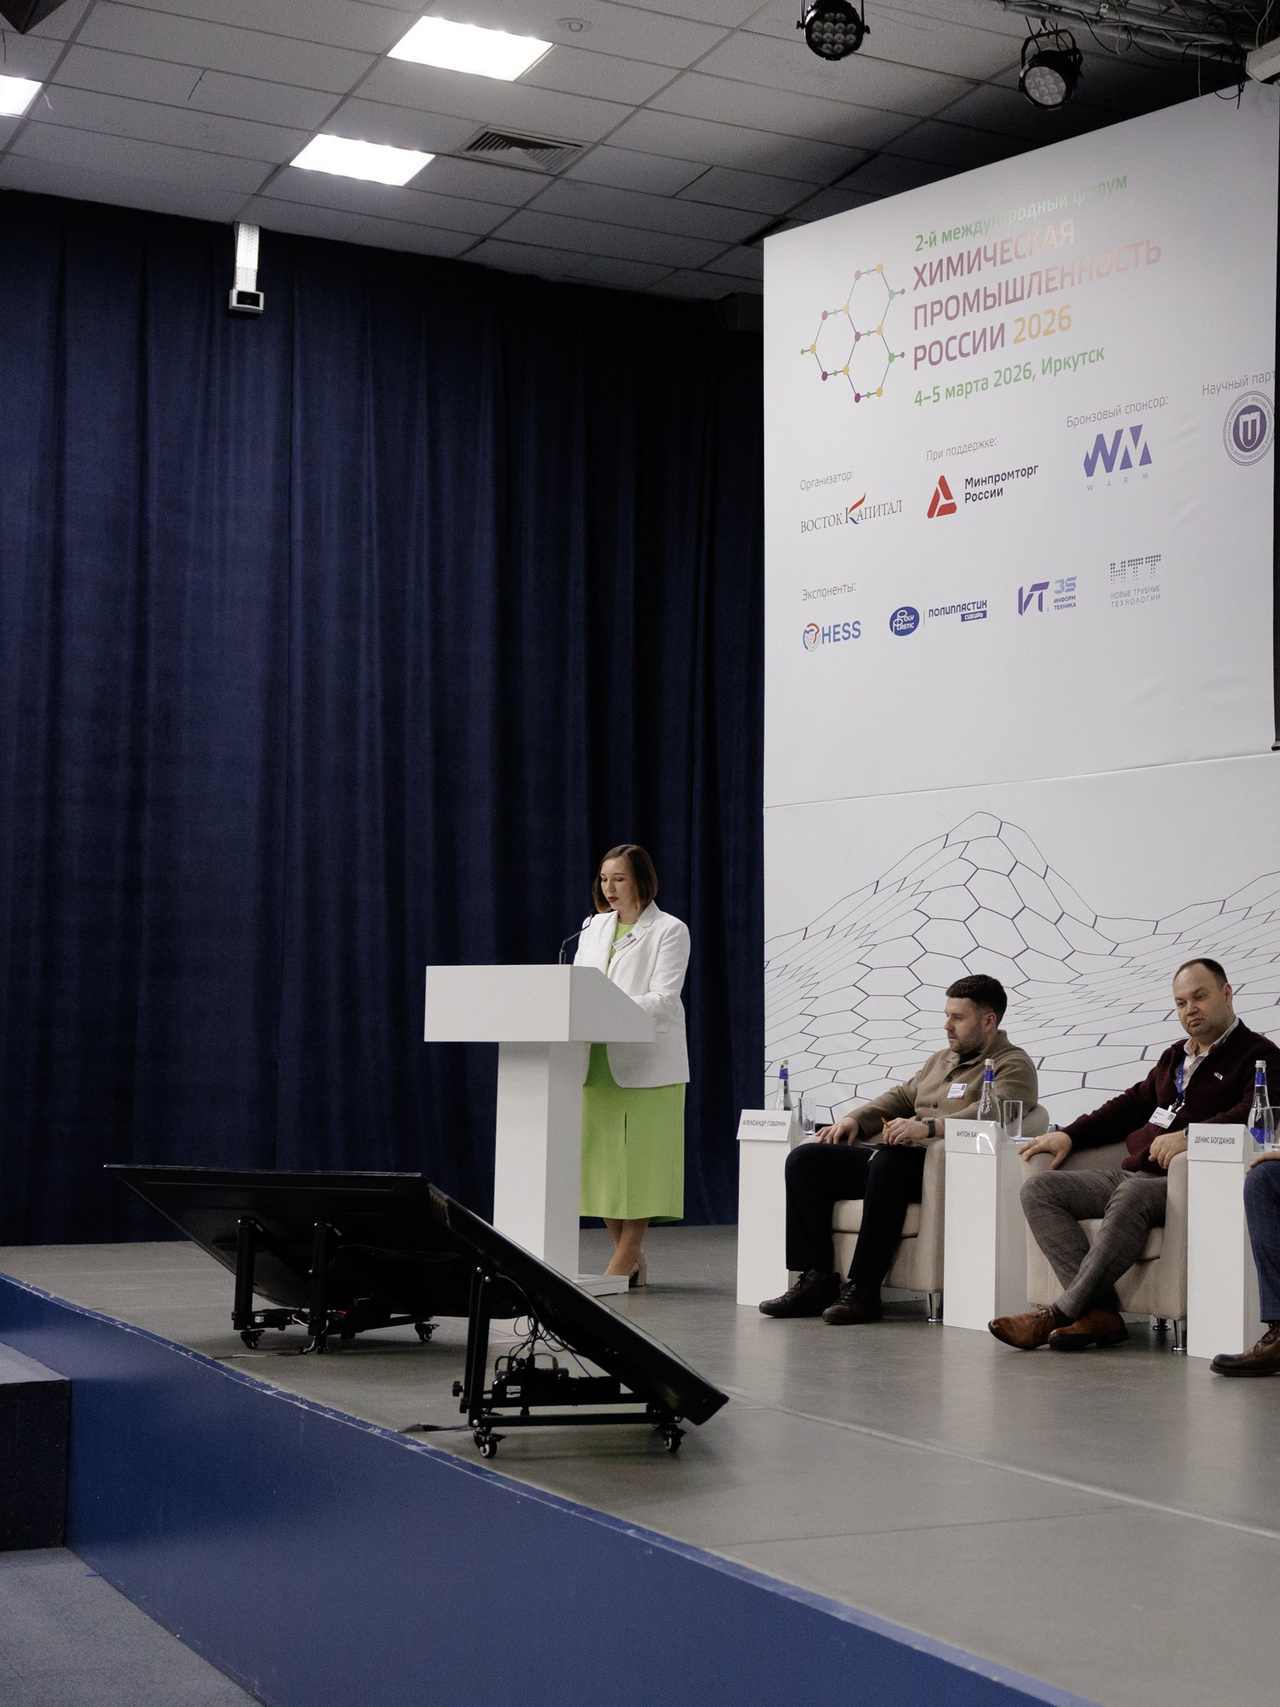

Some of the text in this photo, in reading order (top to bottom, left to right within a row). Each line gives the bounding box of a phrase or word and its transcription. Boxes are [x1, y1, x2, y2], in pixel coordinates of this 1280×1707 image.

[915, 231, 936, 251] 2-й
[942, 193, 1068, 244] международный
[913, 219, 1076, 291] ХИМИЧЕСКАЯ
[914, 238, 1162, 330] ПРОМЫШЛЕННОСТЬ
[914, 305, 1072, 370] РОССИИ 2026
[945, 347, 1105, 399] марта 2026, Иркутск
[1202, 375, 1248, 396] Научный
[1067, 396, 1168, 428] Бронзовый спонсор:
[927, 437, 997, 462] При поддержке:
[800, 470, 854, 491] Организатор:
[965, 465, 1039, 489] Минпромторг
[965, 487, 1003, 503] России
[801, 492, 902, 533] ВОСТОК КАПИТАЛ
[802, 583, 856, 601] Экспоненты:
[1111, 585, 1160, 599] НОВЫЕ ТРУБНЫЕ
[1111, 594, 1160, 608] ТЕХНОЛОГИИ
[929, 600, 987, 617] ПОЛИПЛАСТИК
[1054, 603, 1076, 611] ТЕХНИКА
[822, 621, 861, 644] HESS
[1211, 1137, 1235, 1145] БОГДАНОВ
